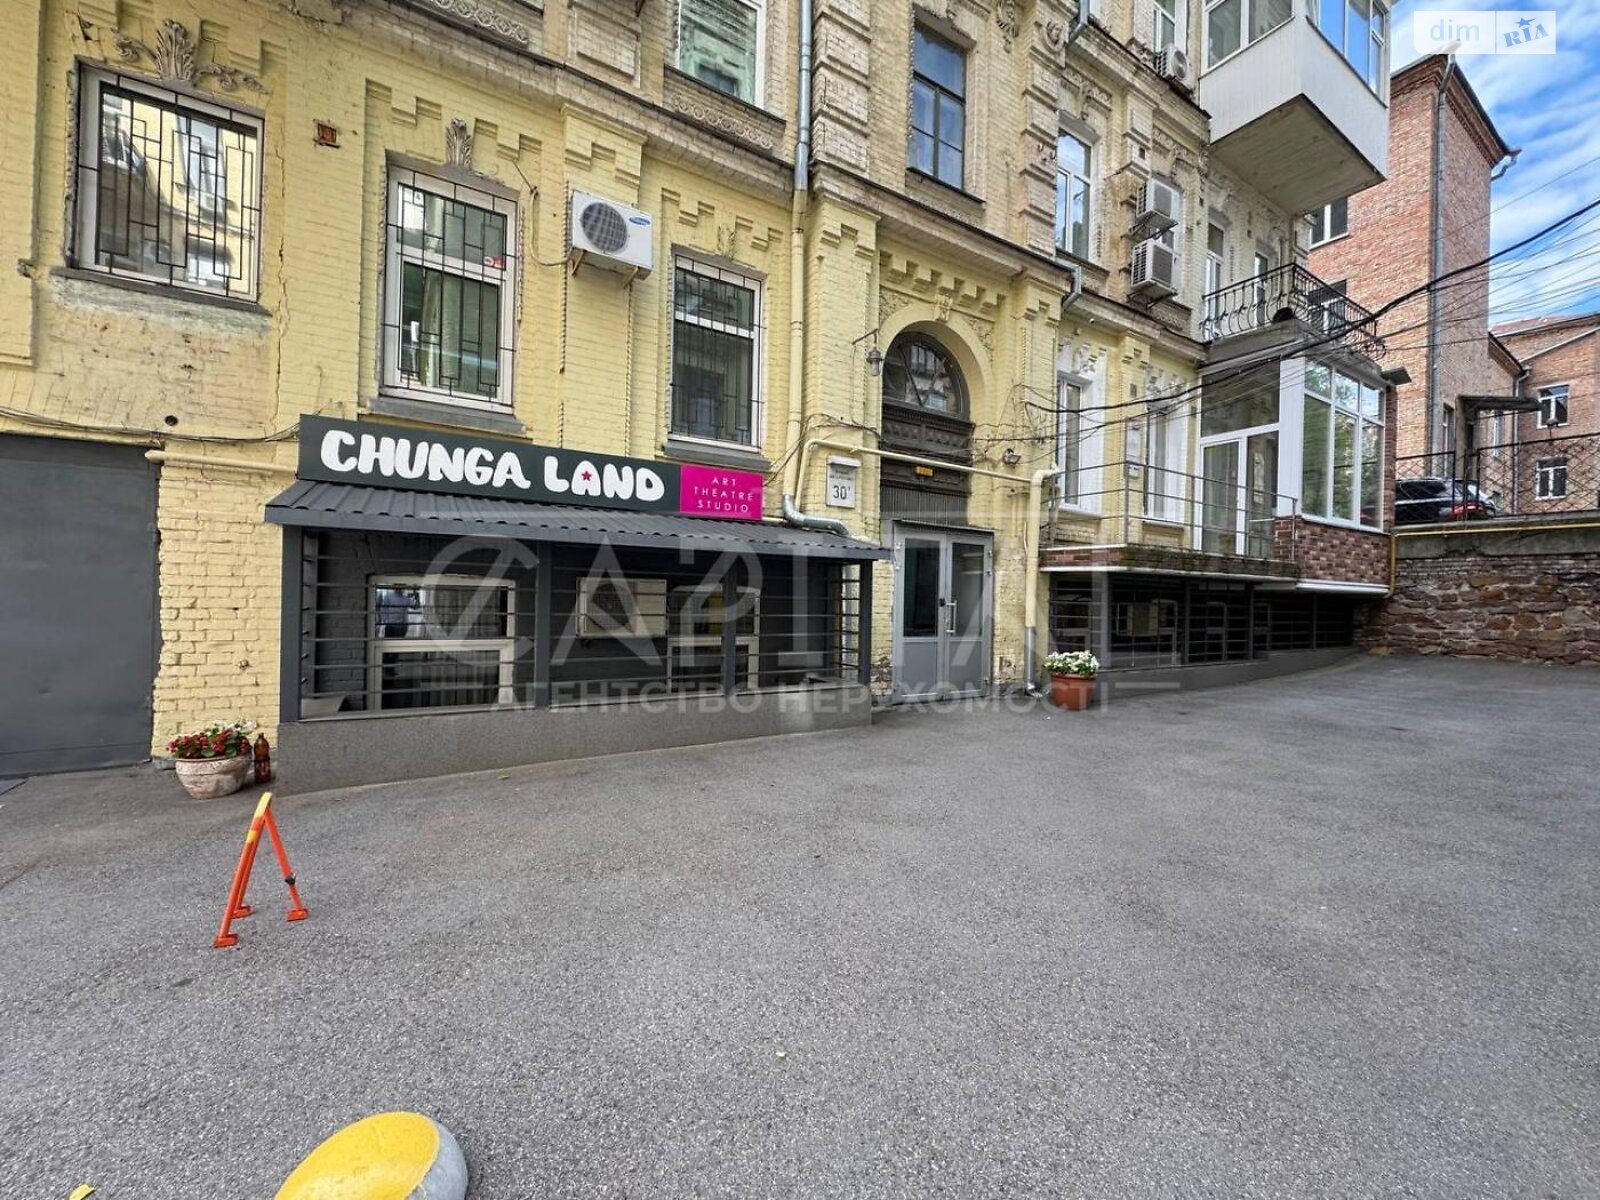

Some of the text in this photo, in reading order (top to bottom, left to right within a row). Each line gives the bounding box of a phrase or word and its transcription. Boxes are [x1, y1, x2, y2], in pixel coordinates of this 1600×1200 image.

[320, 430, 665, 501] CHUNGA LAND
[712, 476, 736, 487] ART
[694, 486, 753, 501] THEATRE
[697, 499, 749, 513] STUDIO
